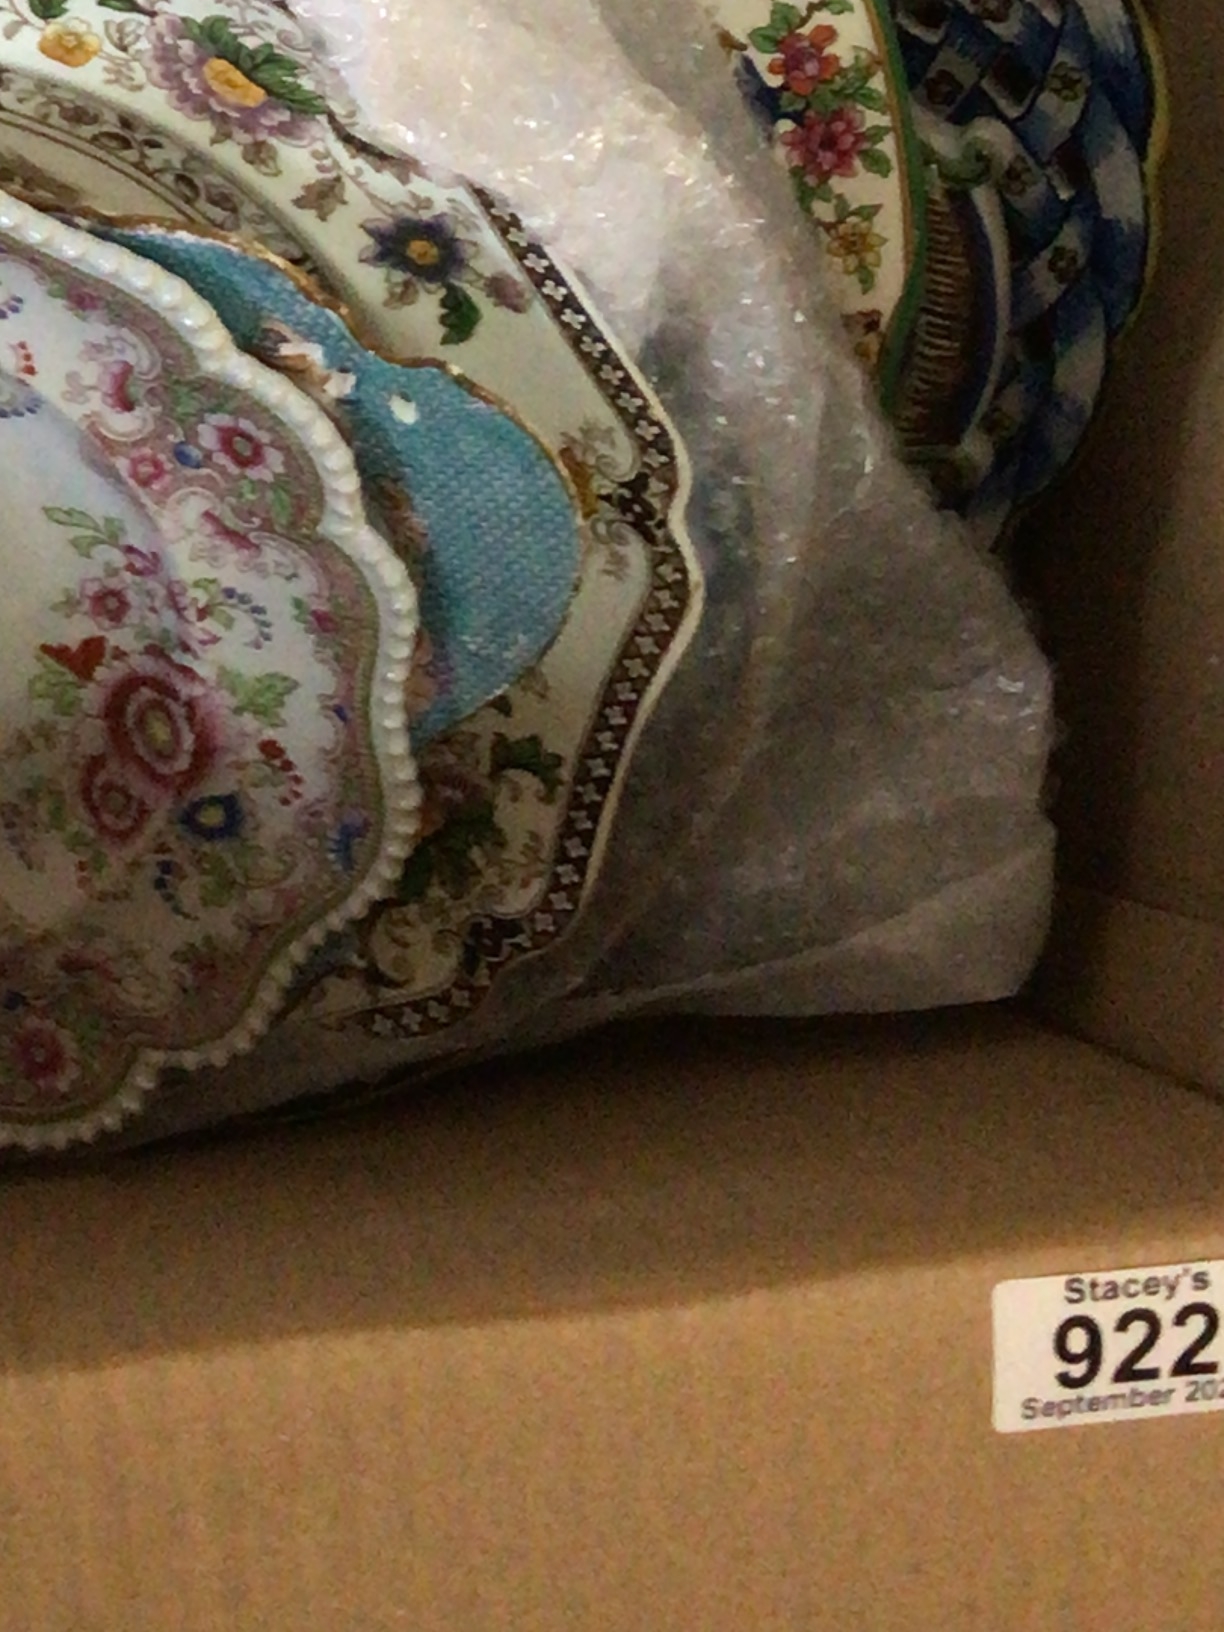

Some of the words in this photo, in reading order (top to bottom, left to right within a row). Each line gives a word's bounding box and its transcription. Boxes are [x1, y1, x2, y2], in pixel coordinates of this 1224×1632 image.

[1064, 1269, 1210, 1304] Stacey's
[1054, 1302, 1219, 1389] 922
[1022, 1387, 1174, 1419] September
